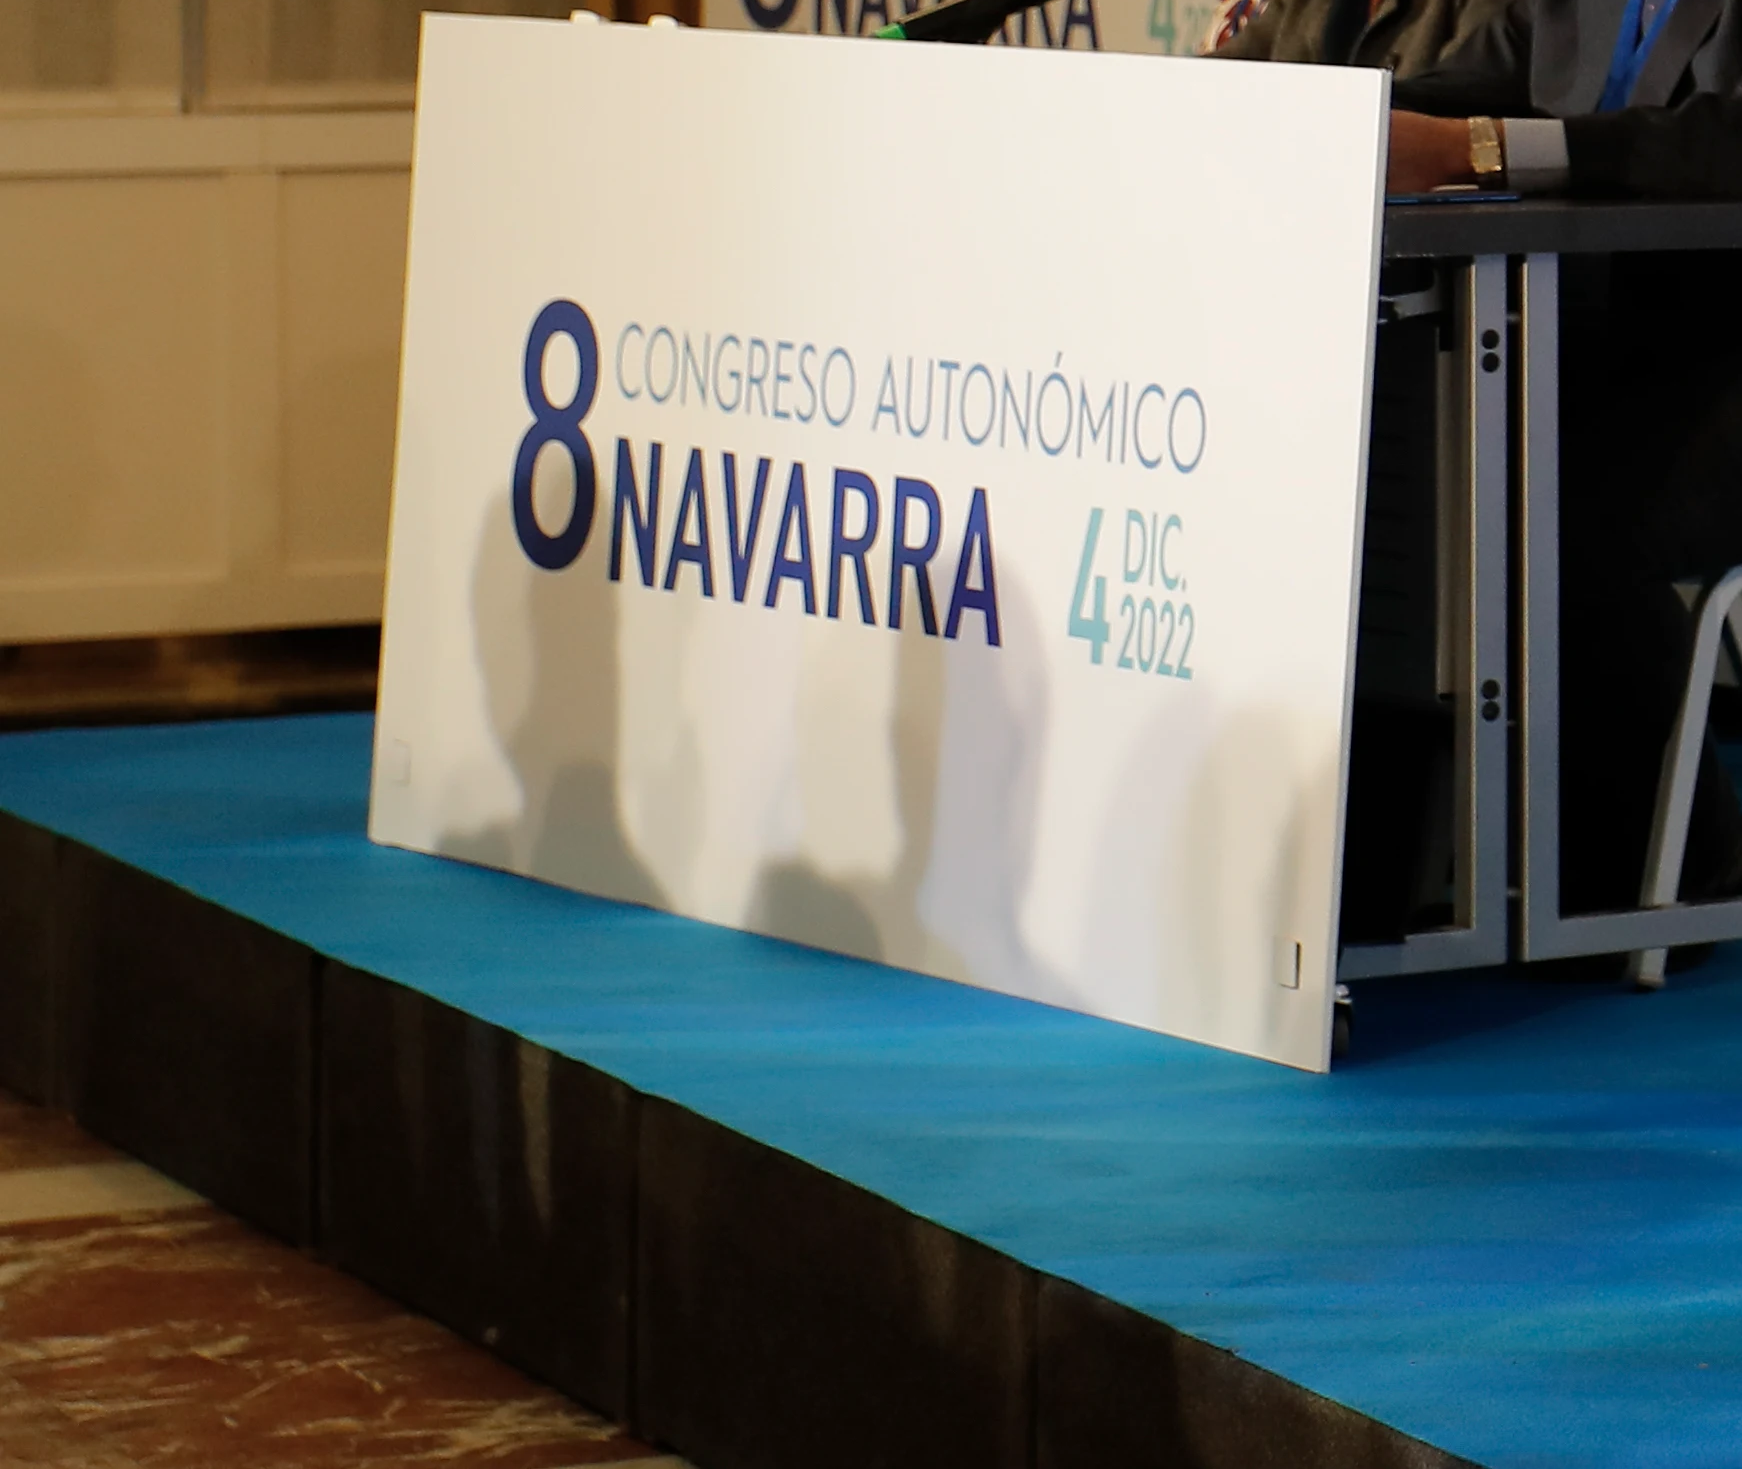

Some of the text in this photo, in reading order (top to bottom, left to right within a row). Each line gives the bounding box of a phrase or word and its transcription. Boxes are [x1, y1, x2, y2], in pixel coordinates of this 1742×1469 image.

[511, 297, 600, 573] 8
[615, 321, 1208, 474] CONGRESO AUTONÓMICO
[607, 435, 1003, 649] NAVARRA
[1067, 506, 1111, 667] 4
[1123, 507, 1188, 593] DIC.
[1116, 598, 1196, 682] 2022
